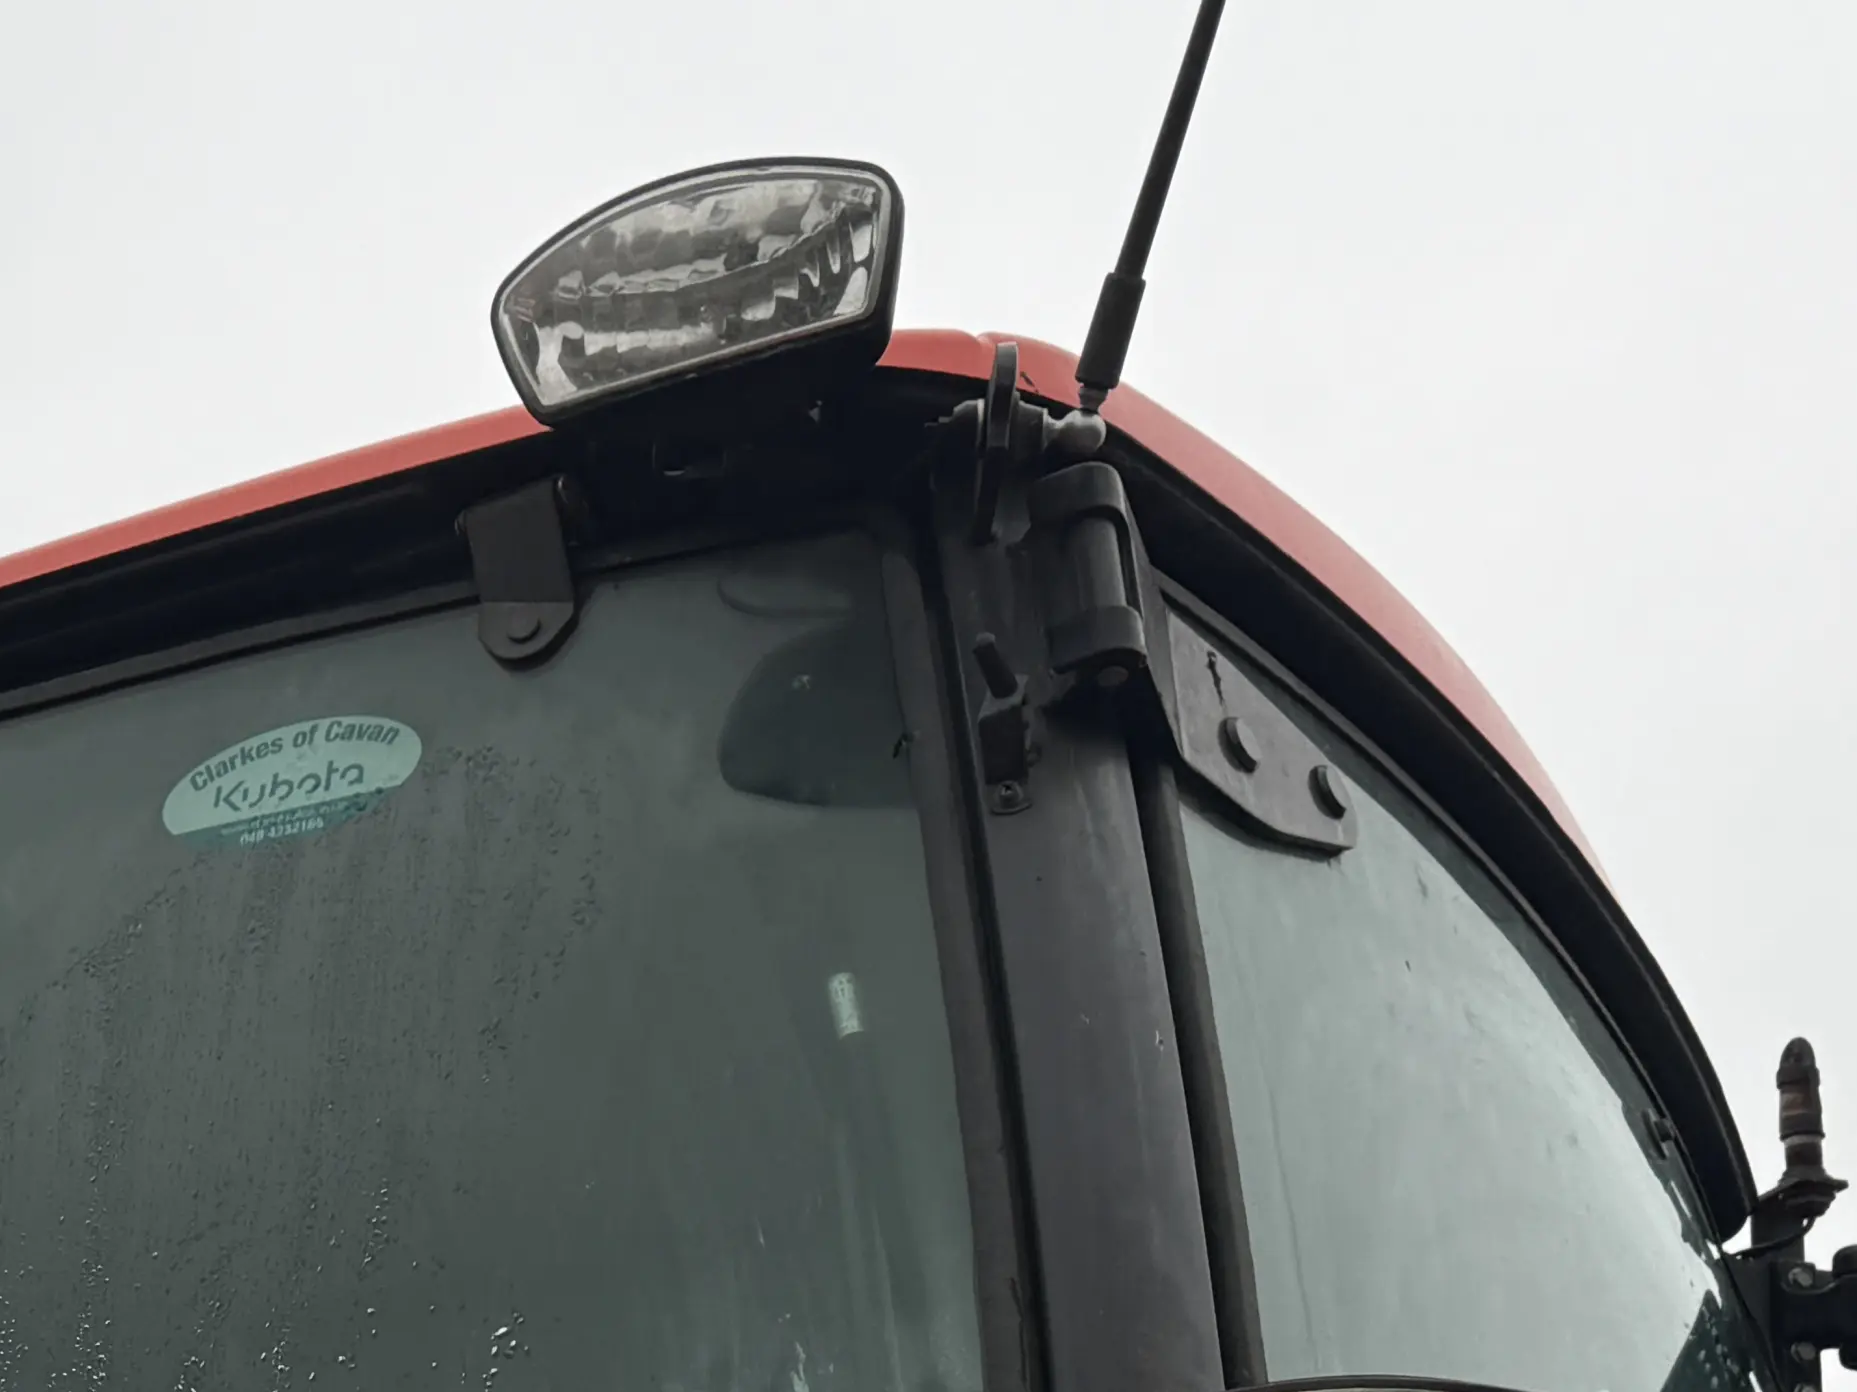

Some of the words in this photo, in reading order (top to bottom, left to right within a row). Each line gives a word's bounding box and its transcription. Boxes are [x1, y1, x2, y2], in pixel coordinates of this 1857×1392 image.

[189, 737, 284, 792] Clarkes
[292, 722, 320, 749] of
[324, 719, 400, 746] Cavan
[213, 759, 365, 813] Kubota
